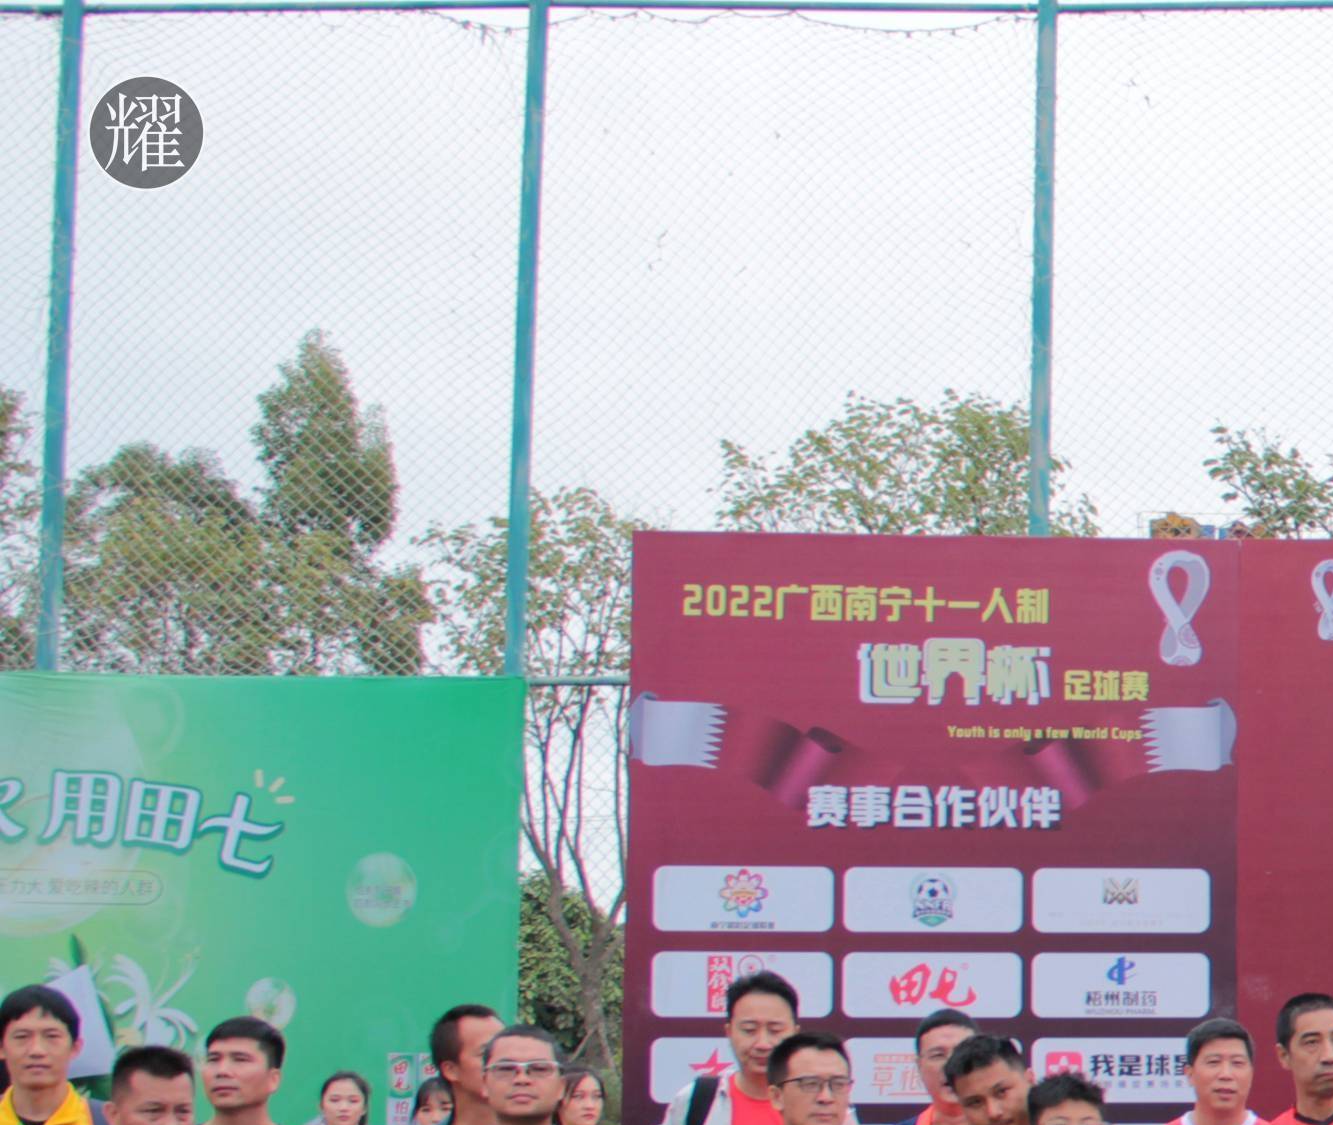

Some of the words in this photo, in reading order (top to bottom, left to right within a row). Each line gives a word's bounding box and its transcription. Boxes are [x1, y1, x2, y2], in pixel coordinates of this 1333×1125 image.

[683, 583, 1050, 625] 2022广西南宁十一人制
[857, 636, 1052, 705] 世界杯
[1063, 669, 1149, 702] 足球赛
[947, 725, 985, 739] Youth
[988, 726, 1000, 738] is
[1003, 726, 1031, 741] only
[1034, 729, 1043, 739] a
[1046, 727, 1069, 739] few
[1072, 727, 1108, 739] World
[1111, 727, 1143, 742] Cups
[808, 785, 1061, 829] 赛事合作伙伴
